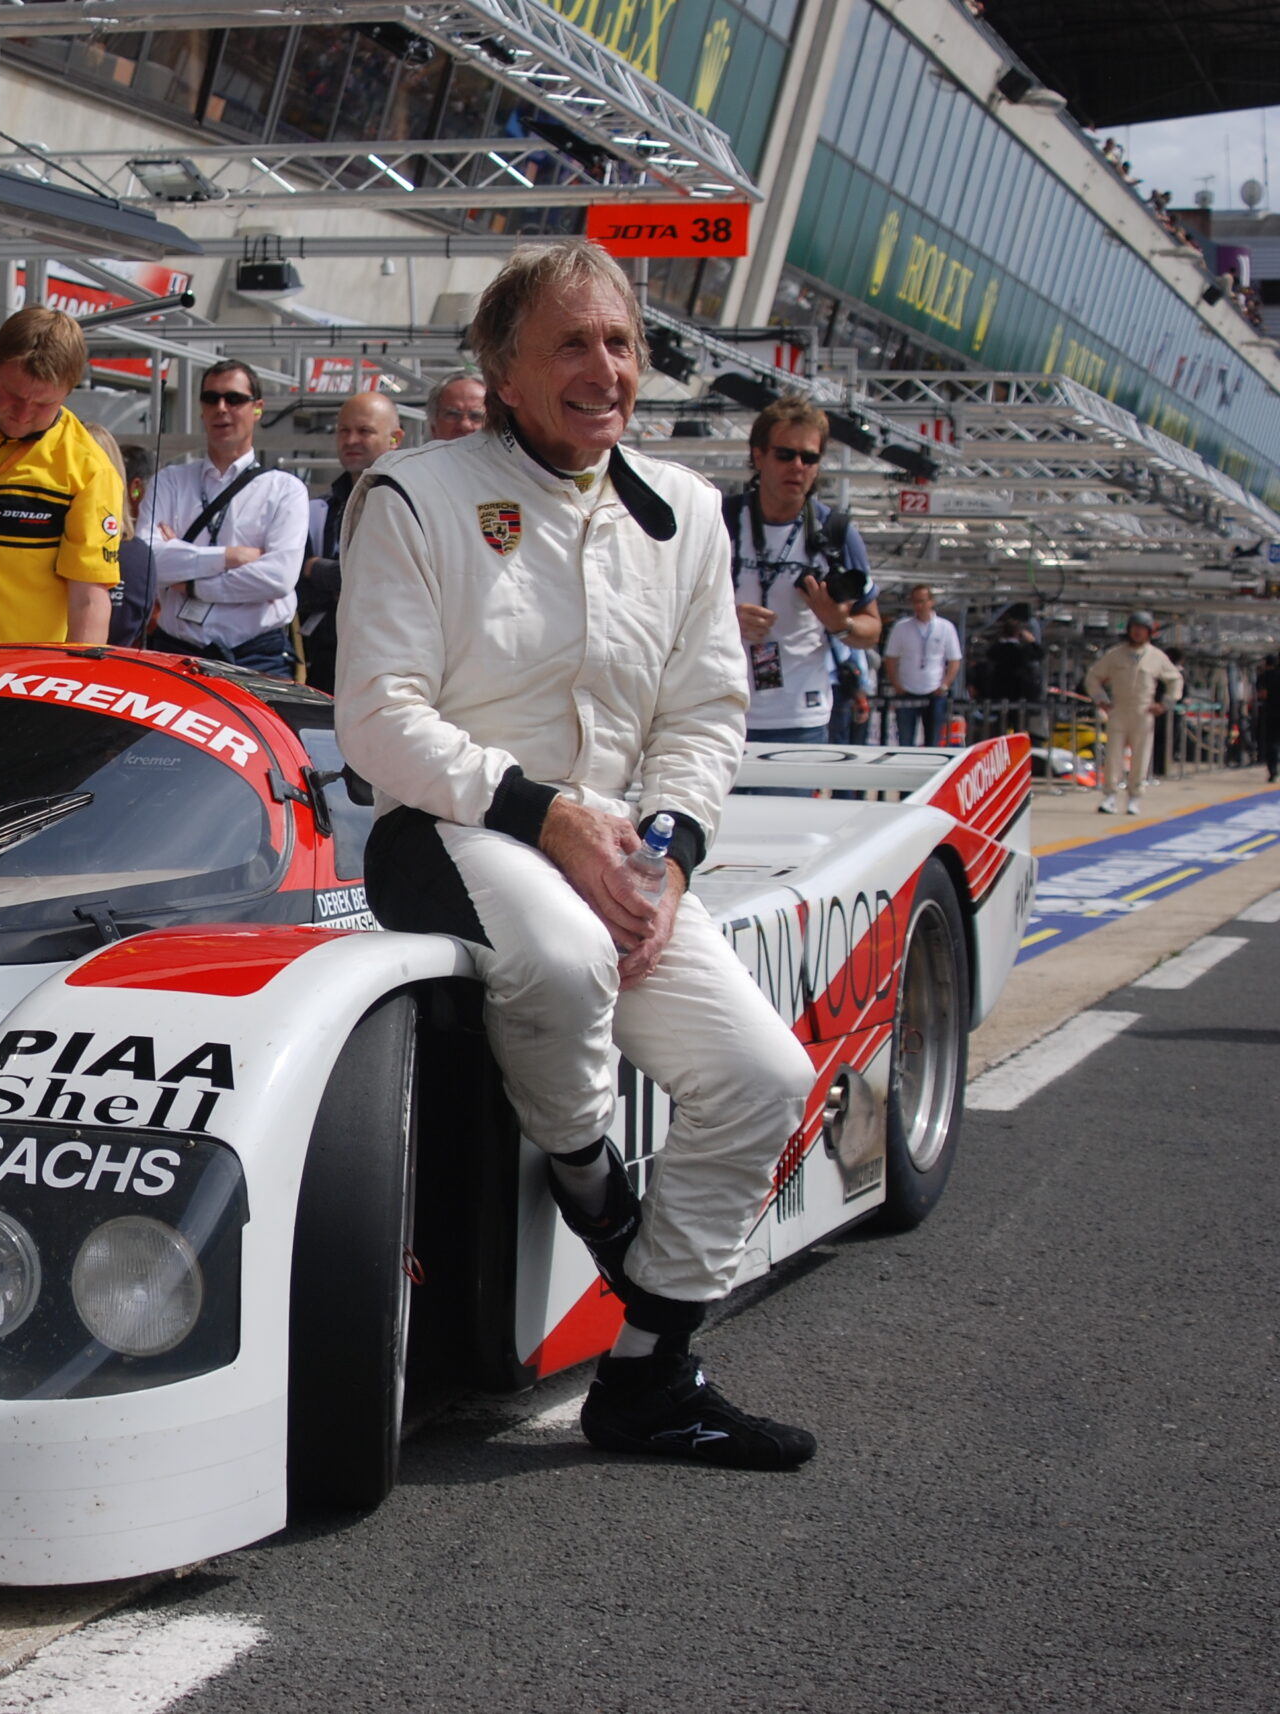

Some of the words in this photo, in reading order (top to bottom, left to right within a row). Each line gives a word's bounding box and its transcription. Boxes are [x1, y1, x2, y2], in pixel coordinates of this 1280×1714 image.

[598, 224, 678, 239] JOTA
[691, 217, 732, 243] 38
[896, 233, 974, 331] ROLEX
[478, 502, 520, 511] PORSCHE
[904, 495, 927, 511] 22
[2, 510, 52, 520] DUNLOP
[123, 751, 182, 767] kremer
[955, 735, 1012, 816] YOKOHAMA
[317, 889, 354, 917] DEREK
